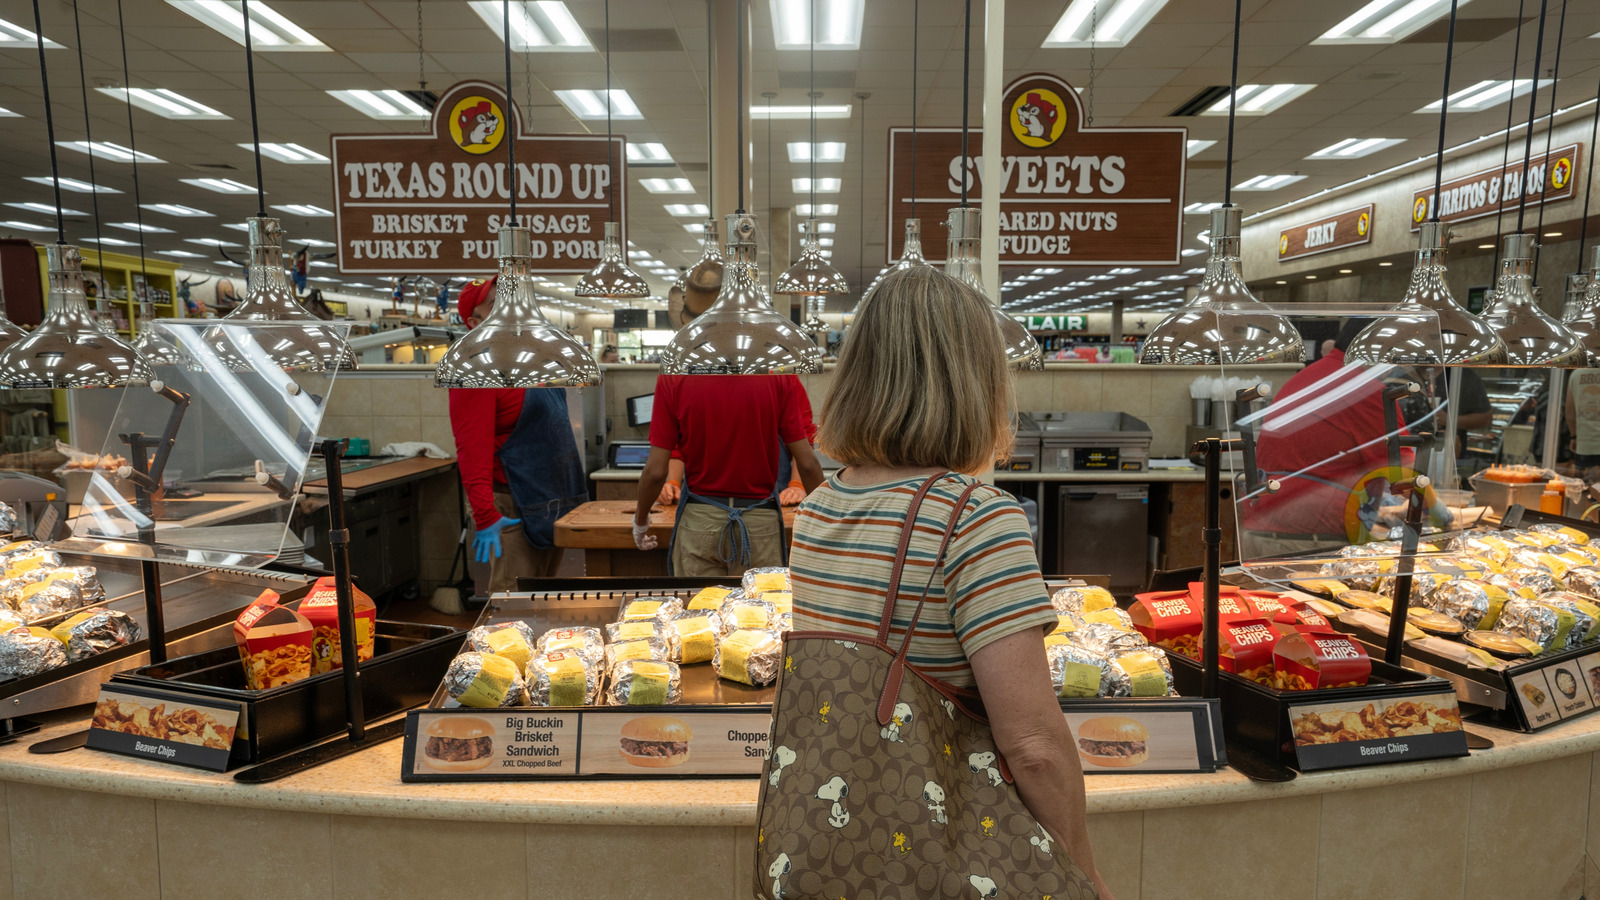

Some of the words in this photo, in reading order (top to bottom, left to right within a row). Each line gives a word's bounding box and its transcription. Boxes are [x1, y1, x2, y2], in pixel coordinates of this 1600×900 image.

[344, 161, 447, 199] TEXAS
[452, 162, 563, 199] ROUND
[569, 163, 610, 200] UP
[948, 155, 1126, 195] SWEETS
[1488, 176, 1501, 205] &
[372, 214, 468, 234] BRISKET
[487, 214, 591, 234] SAUSAGE
[999, 211, 1055, 231] ARED
[1059, 211, 1118, 232] NUTS
[1304, 221, 1338, 248] JERKY
[350, 240, 442, 259] TURKEY
[999, 235, 1071, 255] FUDGE
[307, 596, 338, 607] CHIPS
[1152, 598, 1186, 609] BEAVER
[1157, 604, 1192, 618] CHIPS
[1229, 623, 1267, 636] BEAVER
[1235, 631, 1274, 646] CHIPS
[1314, 638, 1352, 648] BEAVER
[1321, 646, 1360, 660] CHIPS
[506, 717, 523, 731] Big
[526, 717, 563, 728] Buckin
[515, 731, 553, 742] Brisket
[727, 729, 768, 744] Choppe
[135, 741, 158, 754] Beaver
[157, 745, 177, 758] Chips
[506, 745, 560, 757] Sandwich
[744, 745, 765, 757] San
[1360, 745, 1387, 756] Beaver
[1387, 742, 1409, 754] Chips
[516, 759, 546, 768] Chopped
[547, 759, 562, 767] Beef
